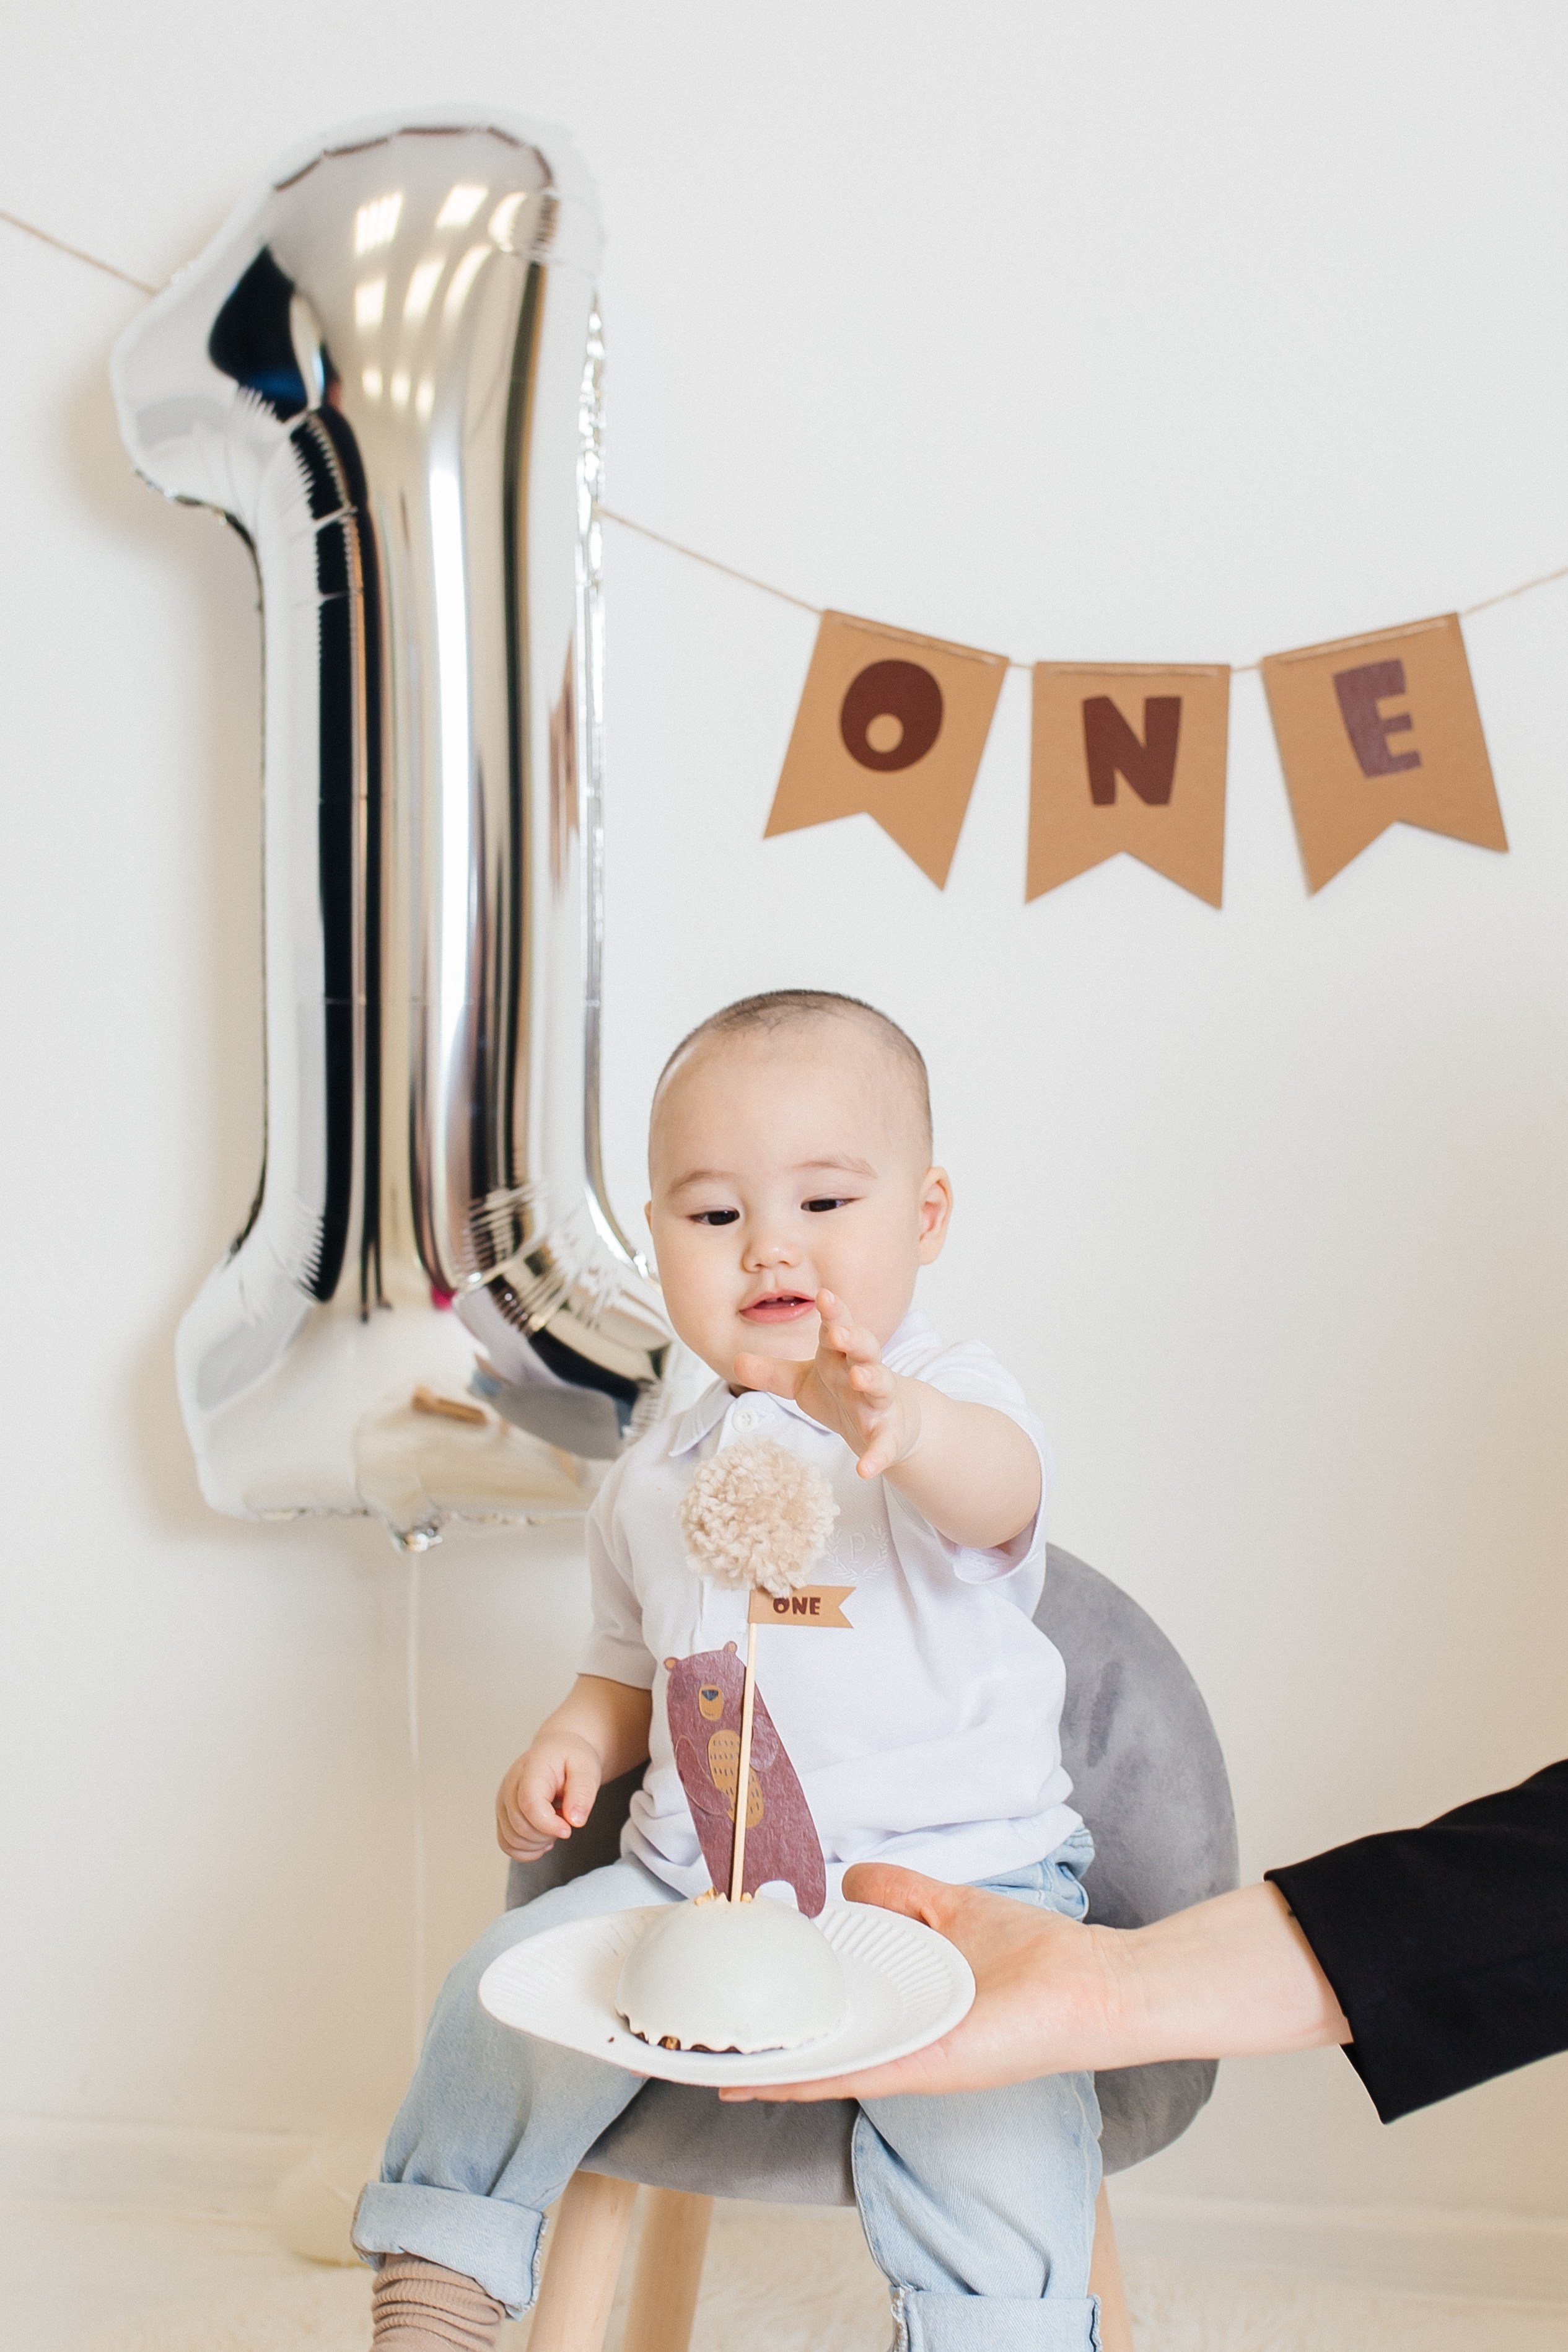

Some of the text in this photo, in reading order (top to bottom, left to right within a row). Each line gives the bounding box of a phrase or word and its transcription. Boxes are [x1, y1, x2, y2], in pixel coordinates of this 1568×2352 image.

[839, 659, 1422, 806] ONE
[110, 104, 694, 1543] 1
[848, 1532, 866, 1563] P
[773, 1597, 821, 1615] ONE
